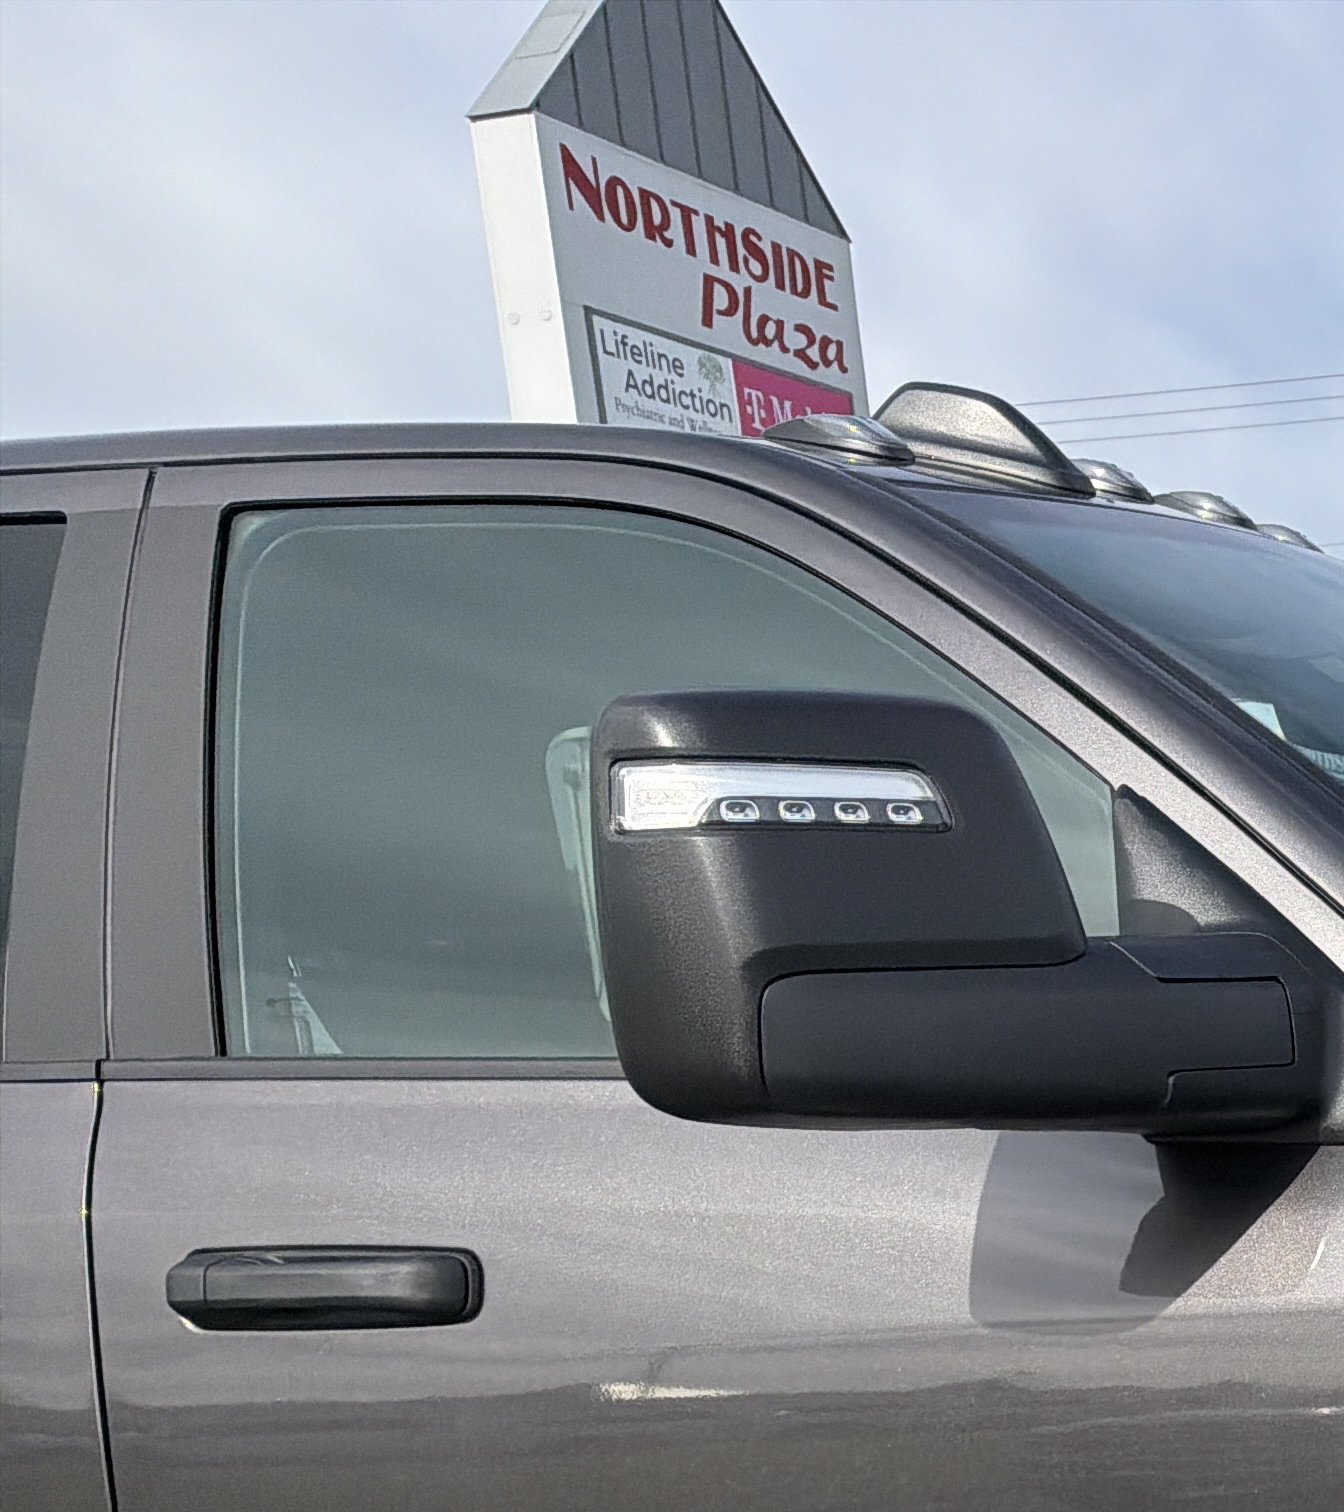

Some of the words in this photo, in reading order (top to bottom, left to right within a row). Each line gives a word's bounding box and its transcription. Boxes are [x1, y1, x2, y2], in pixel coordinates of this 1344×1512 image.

[701, 271, 849, 374] Plaza
[599, 327, 685, 378] Lifeline
[624, 368, 733, 423] Addiction
